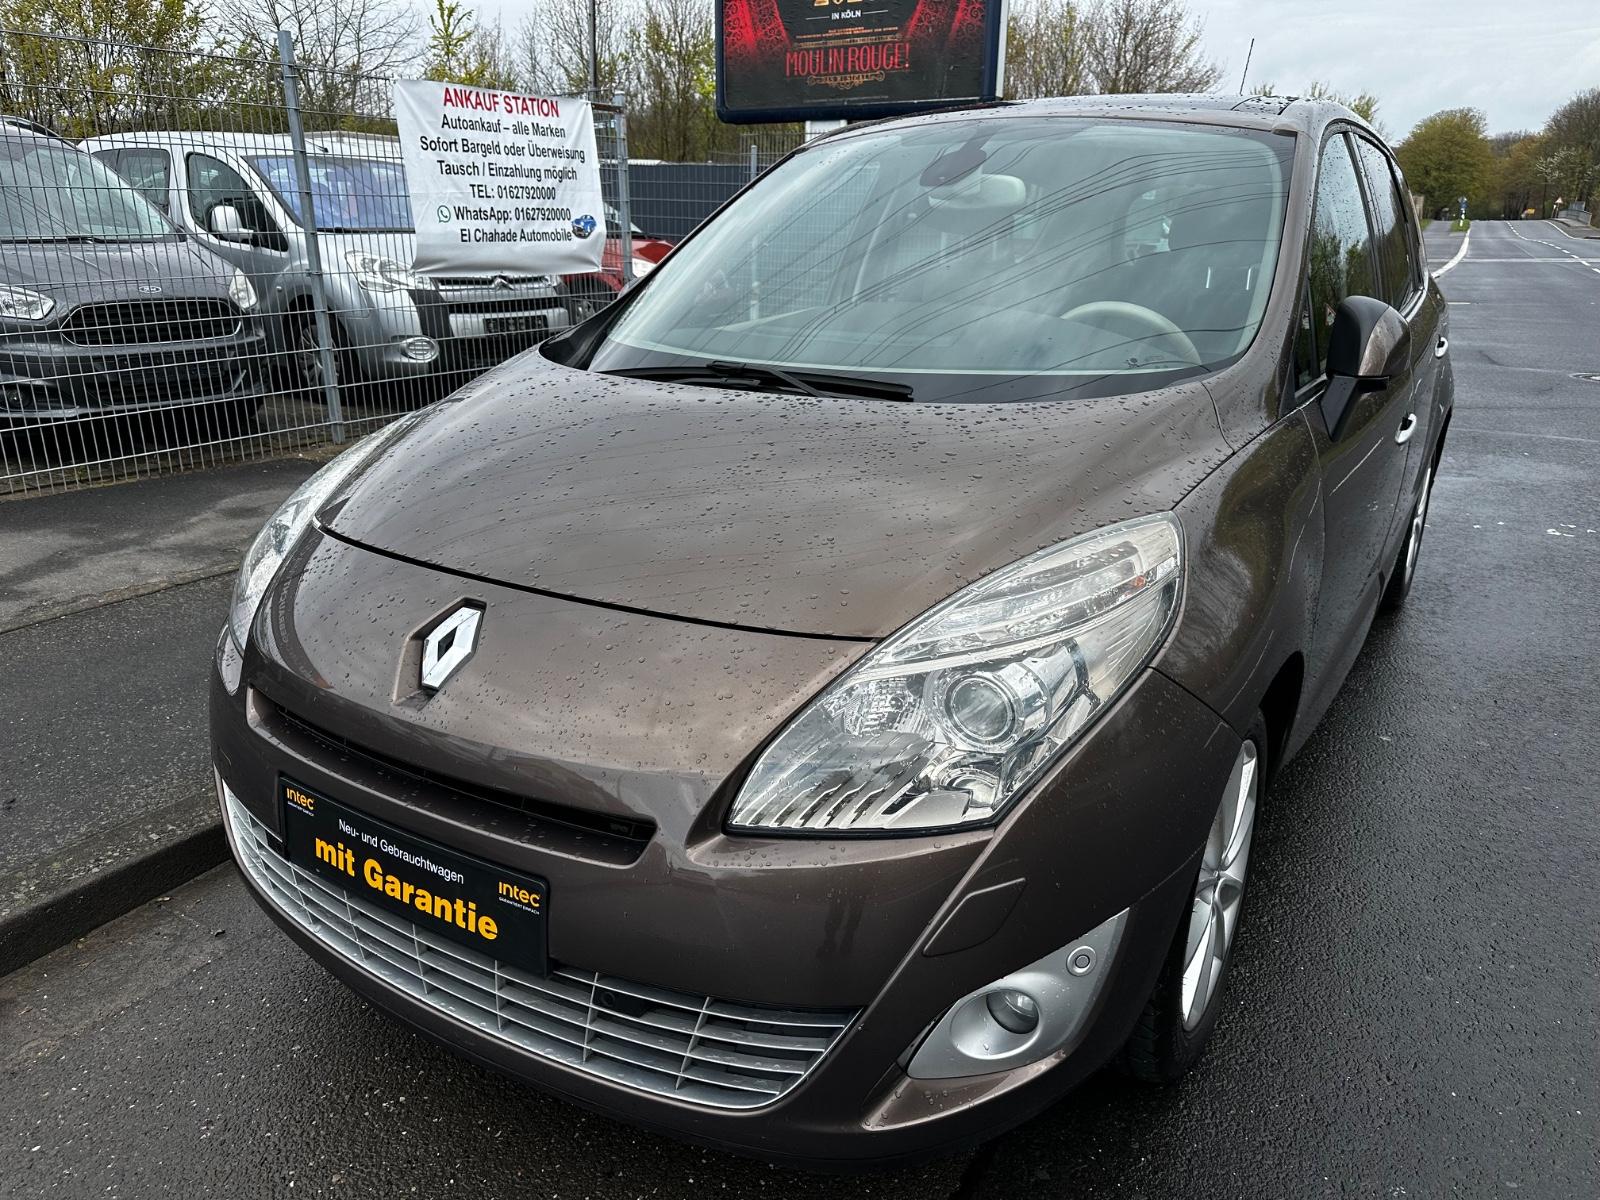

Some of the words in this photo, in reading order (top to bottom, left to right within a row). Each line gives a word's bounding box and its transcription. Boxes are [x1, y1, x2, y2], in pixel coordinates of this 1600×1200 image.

[831, 12, 840, 20] IN
[841, 9, 862, 19] KÖLN
[785, 47, 844, 77] MOULIN
[847, 42, 910, 72] ROUGE!
[443, 87, 500, 112] ANKAUF
[503, 95, 560, 118] STATION
[441, 114, 501, 133] Autoankauf
[512, 121, 530, 135] alle
[532, 123, 566, 138] Marken
[420, 136, 459, 153] Sofort
[461, 138, 502, 158] Bargeld
[503, 142, 525, 157] oder
[527, 140, 586, 163] Überweisung
[437, 160, 480, 176] Tausch
[488, 163, 542, 182] Einzahlung
[543, 166, 578, 183] möglich
[469, 184, 495, 199] TEL:
[497, 185, 556, 200] 01627920000
[453, 205, 512, 224] WhatsApp:
[514, 207, 571, 221] 01627920000
[460, 228, 471, 243] El
[474, 228, 518, 242] Chahade
[519, 228, 573, 242] Automobile
[338, 818, 360, 837] Neu-
[361, 832, 378, 848] und
[379, 839, 465, 885] Gebrauchtwagen
[315, 837, 355, 877] mit
[363, 858, 499, 940] Garantie
